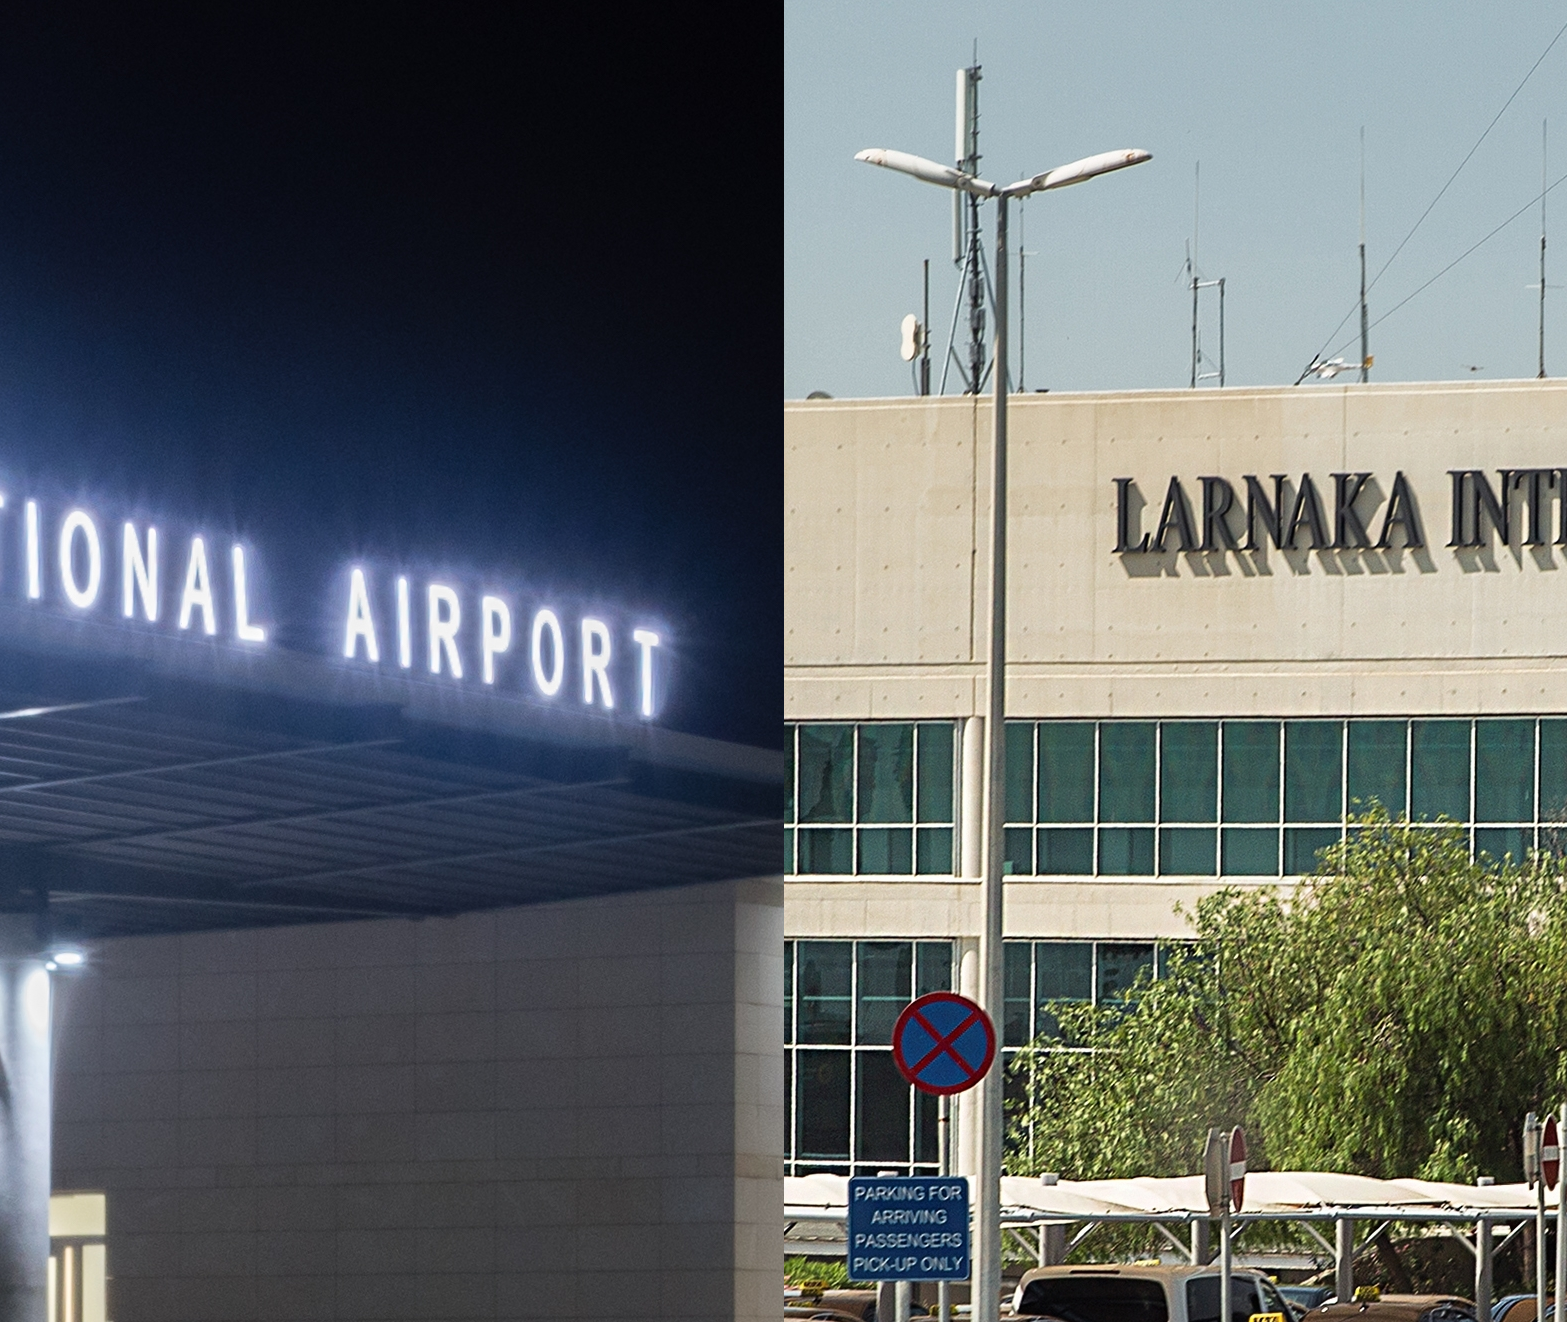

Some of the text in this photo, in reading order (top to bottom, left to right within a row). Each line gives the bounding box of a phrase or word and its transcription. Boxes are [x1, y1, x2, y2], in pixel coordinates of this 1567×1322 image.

[1111, 470, 1424, 554] LARNAKA
[344, 567, 661, 718] AIRPORT
[854, 1185, 962, 1201] PARKING FOR
[871, 1209, 947, 1225] ARRIVING
[854, 1233, 963, 1248] PASSENGERS
[853, 1256, 963, 1272] PICK-UP ONLY
